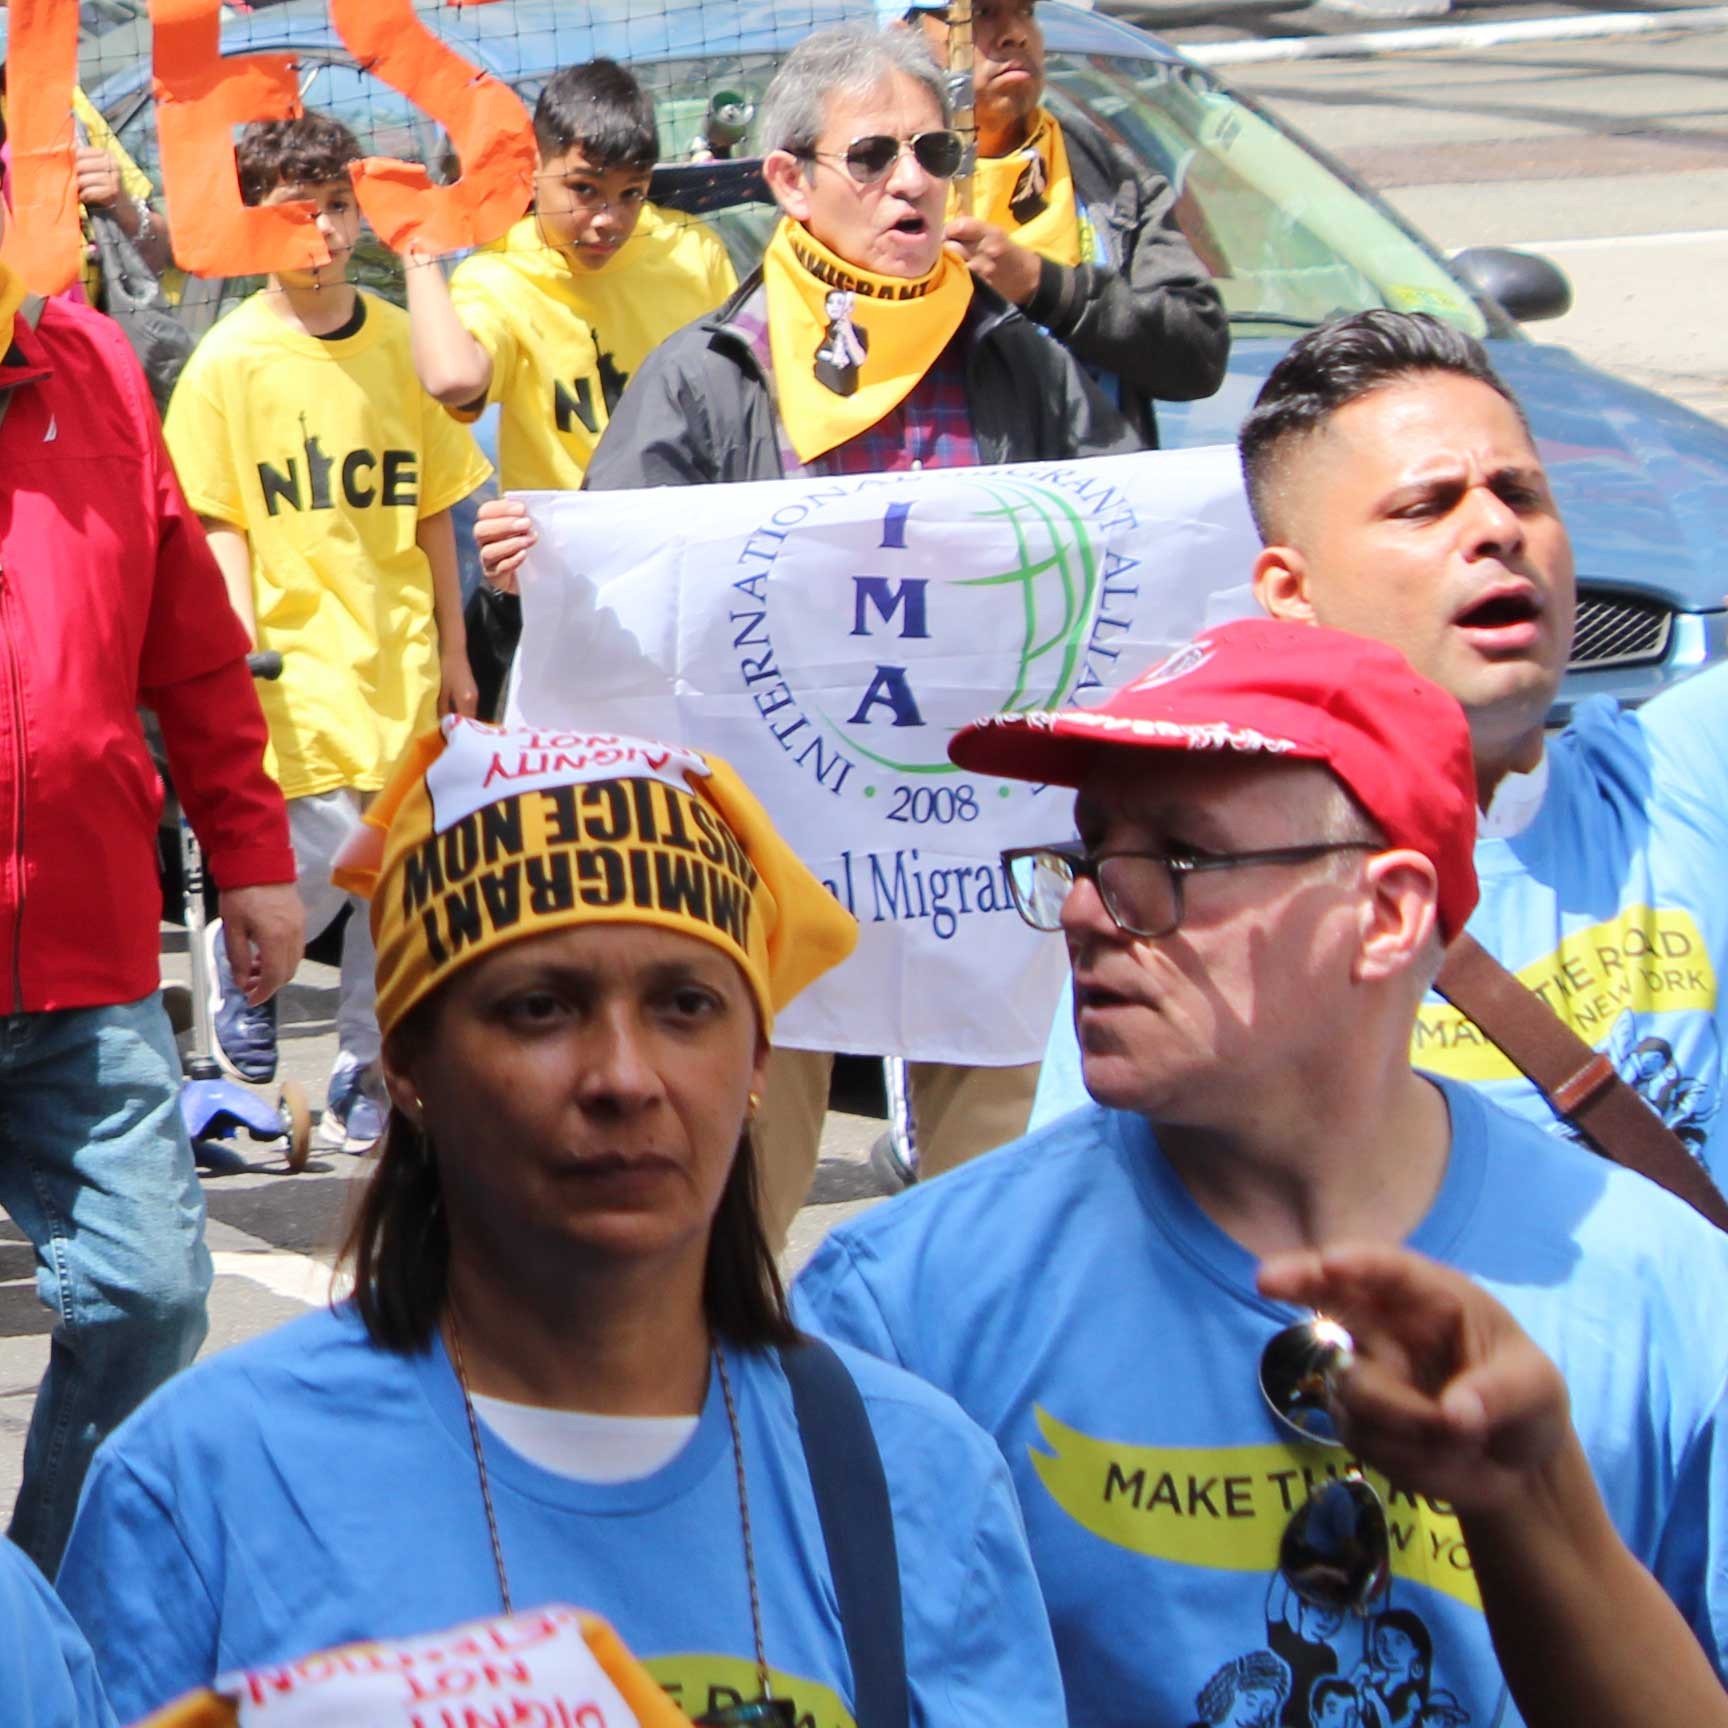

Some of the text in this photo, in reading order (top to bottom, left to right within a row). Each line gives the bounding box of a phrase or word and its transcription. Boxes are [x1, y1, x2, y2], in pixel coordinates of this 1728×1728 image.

[256, 437, 419, 517] NICE
[887, 784, 980, 824] 2008
[402, 794, 524, 922] NOW
[1102, 1462, 1256, 1520] MAKE
